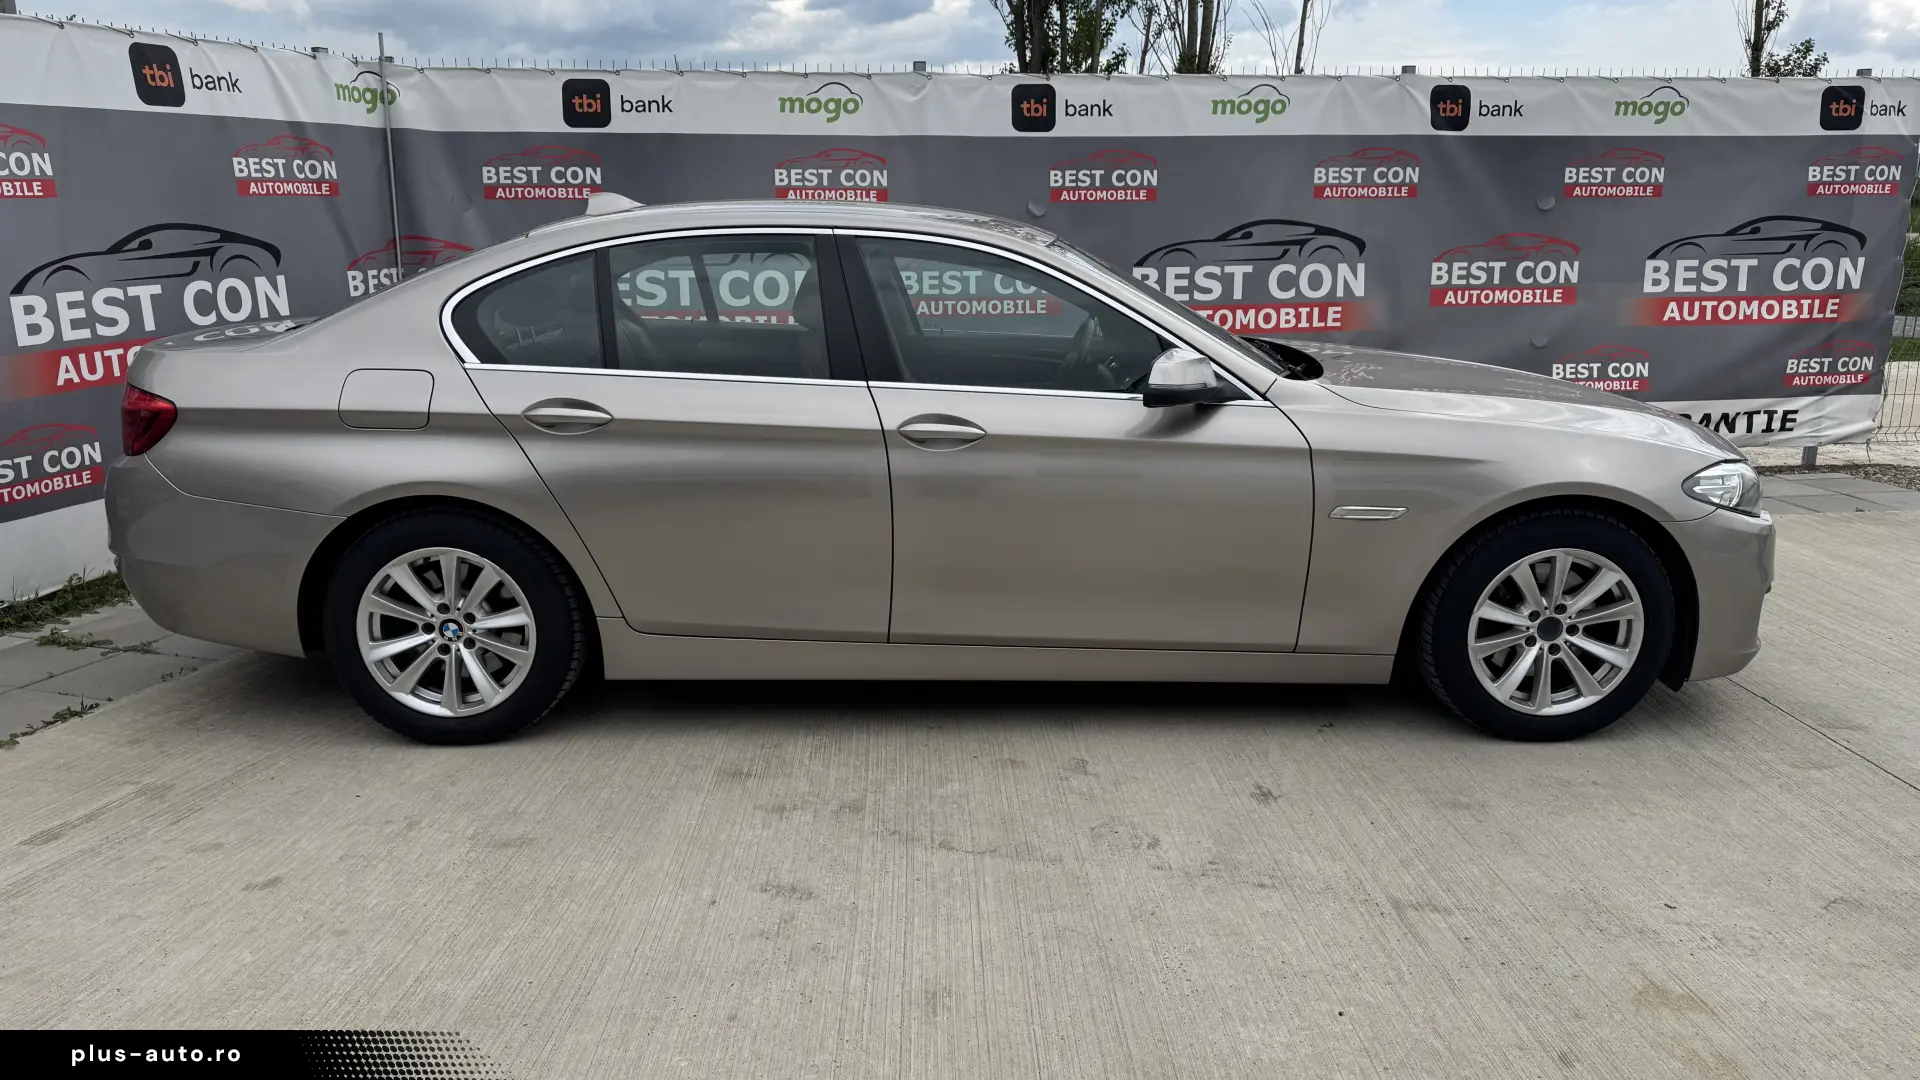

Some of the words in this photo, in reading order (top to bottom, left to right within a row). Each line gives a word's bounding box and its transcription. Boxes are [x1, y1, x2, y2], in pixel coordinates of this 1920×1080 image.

[142, 64, 175, 88] tbi
[190, 68, 243, 94] bank
[572, 95, 601, 113] tbi
[620, 94, 674, 114] bank
[778, 95, 860, 123] mogo
[1021, 99, 1047, 117] tbi
[1064, 98, 1114, 117] bank
[1211, 97, 1288, 123] mogo
[1439, 100, 1462, 117] tbi
[1478, 99, 1525, 117] bank
[1614, 97, 1687, 124] mogo
[1831, 100, 1856, 117] tbi
[1870, 99, 1907, 117] bank
[232, 156, 287, 178] BEST
[292, 159, 338, 180] CON
[482, 166, 542, 184] BEST
[550, 166, 602, 185] CON
[774, 168, 833, 187] BEST
[840, 168, 888, 187] CON
[1313, 167, 1367, 184] BEST
[1373, 166, 1420, 184] CON
[1564, 167, 1616, 184] BEST
[1622, 166, 1665, 184] CON
[1807, 165, 1860, 182] BEST
[1864, 164, 1902, 181] CON
[1049, 169, 1105, 187] BEST
[1111, 169, 1158, 187] CON
[0, 181, 44, 196] BILE
[249, 182, 330, 195] AUTOMOBILE
[495, 187, 591, 199] AUTOMOBILE
[787, 189, 877, 202] AUTOMOBILE
[1060, 189, 1147, 201] AUTOMOBILE
[1323, 186, 1409, 197] AUTOMOBILE
[1573, 186, 1654, 197] AUTOMOBILE
[1816, 184, 1892, 195] AUTOMOBILE
[899, 270, 983, 295] BEST
[1268, 262, 1366, 300] CON
[1430, 261, 1507, 286] BEST
[1515, 260, 1580, 285] CON
[1642, 258, 1759, 293] BEST
[1772, 256, 1866, 292] CON
[718, 268, 807, 307] CO
[1443, 289, 1563, 305] AUTOMOBILE
[9, 284, 164, 347] BEST
[183, 274, 291, 326] CON
[916, 299, 1047, 315] AUTOMOBILE
[1662, 298, 1840, 321] AUTOMOBILE
[1551, 362, 1602, 379] BEST
[1607, 362, 1649, 378] CON
[1785, 357, 1833, 374] BEST
[1837, 355, 1874, 372] CON
[1792, 373, 1864, 386] AUTOMOBILE
[1677, 409, 1800, 434] ANTIE
[42, 441, 102, 474] CON
